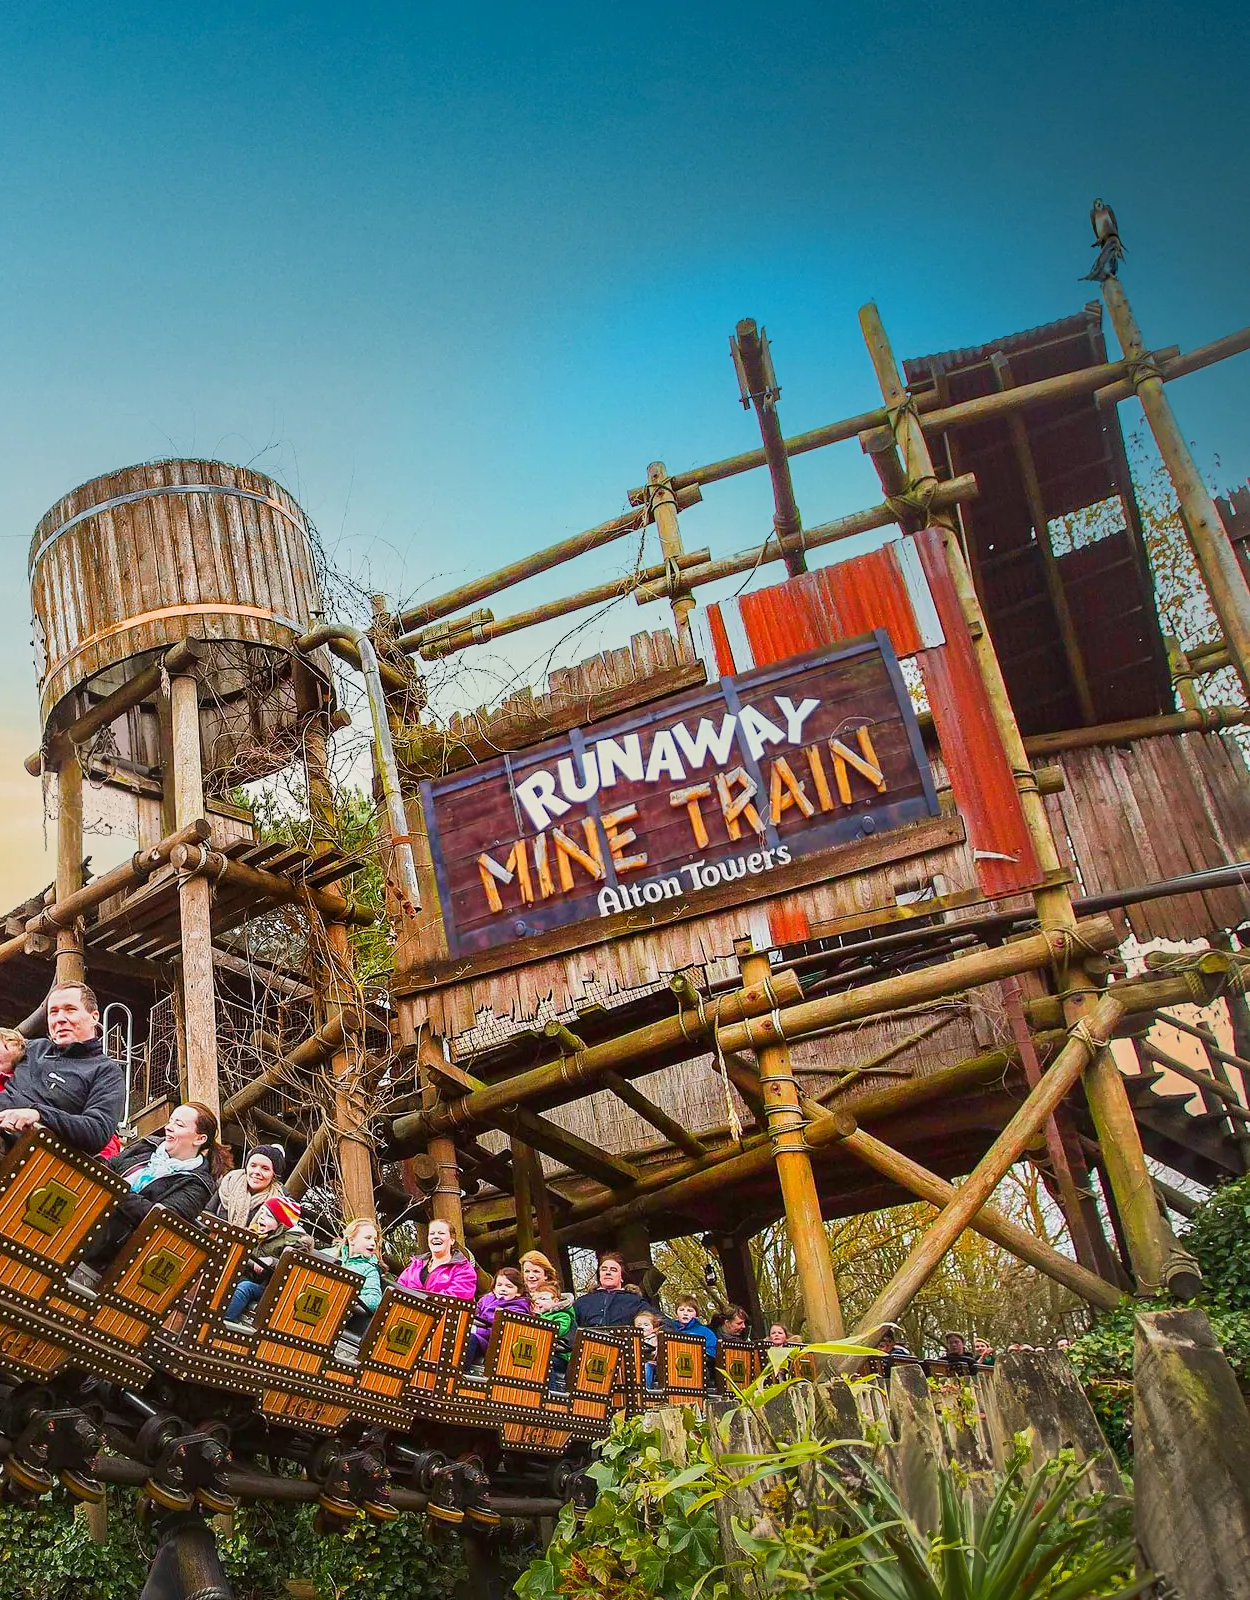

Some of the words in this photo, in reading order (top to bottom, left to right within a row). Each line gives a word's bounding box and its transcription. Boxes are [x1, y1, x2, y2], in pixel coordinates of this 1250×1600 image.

[477, 804, 649, 913] MINE
[669, 725, 886, 850] TRAIN
[515, 695, 820, 832] RUNAWAY
[597, 876, 683, 918] Alton
[680, 844, 791, 891] Towers
